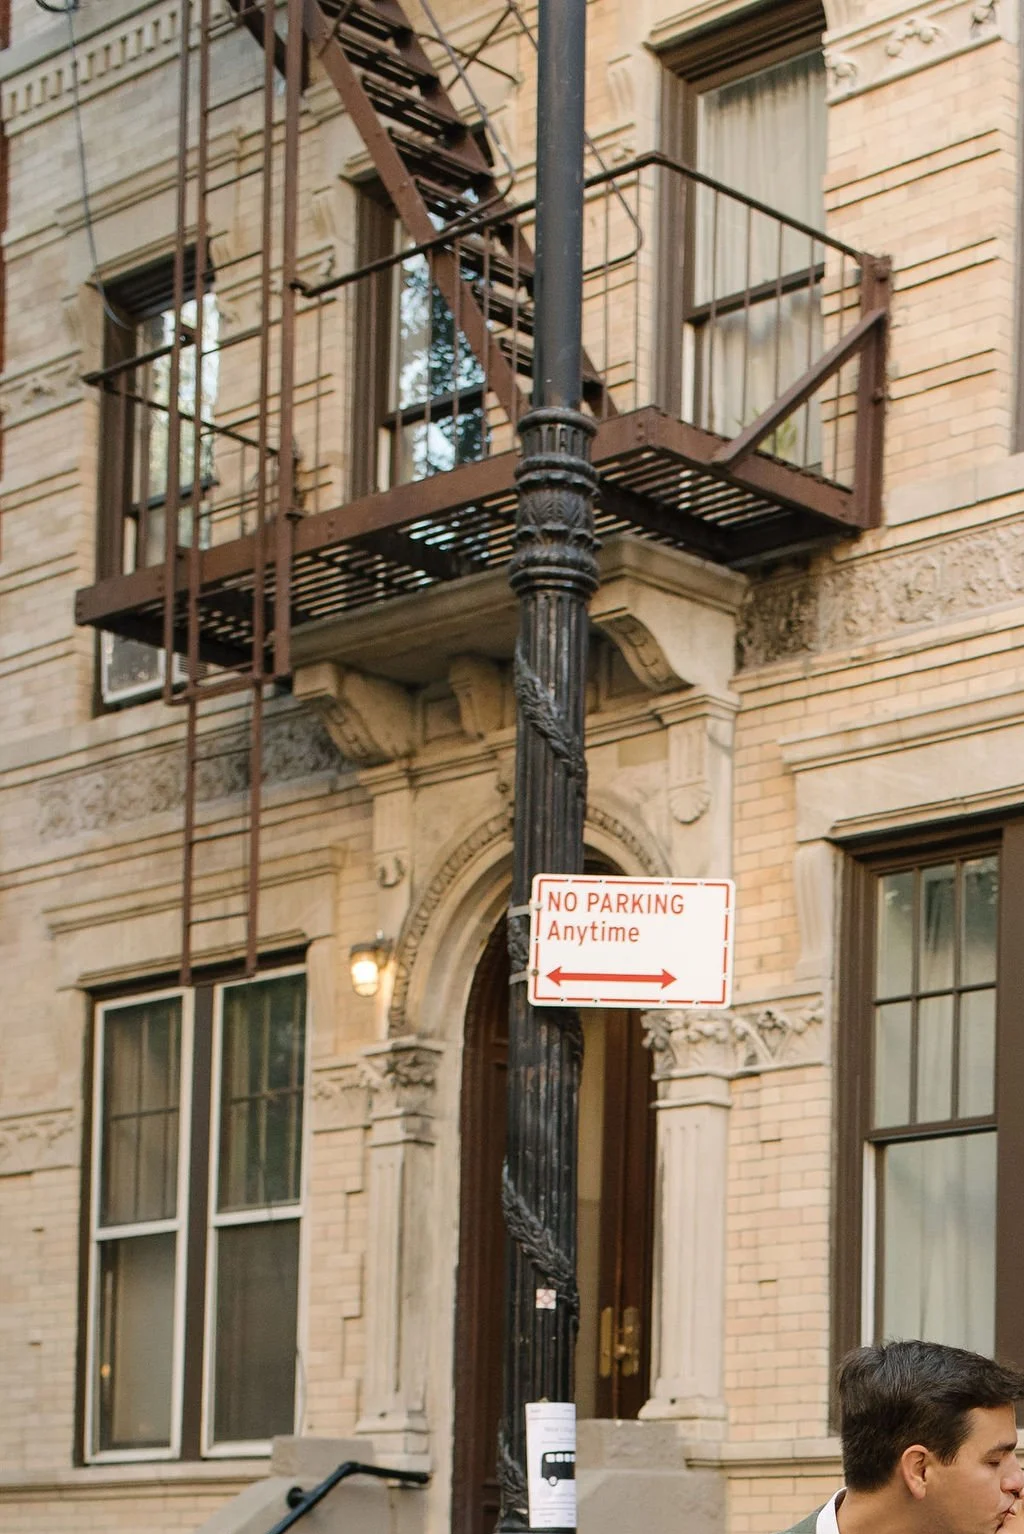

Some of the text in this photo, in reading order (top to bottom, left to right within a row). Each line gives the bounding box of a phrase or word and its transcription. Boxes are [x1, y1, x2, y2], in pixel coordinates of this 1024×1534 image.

[547, 891, 685, 915] NO PARKING
[547, 920, 641, 946] Anytime
